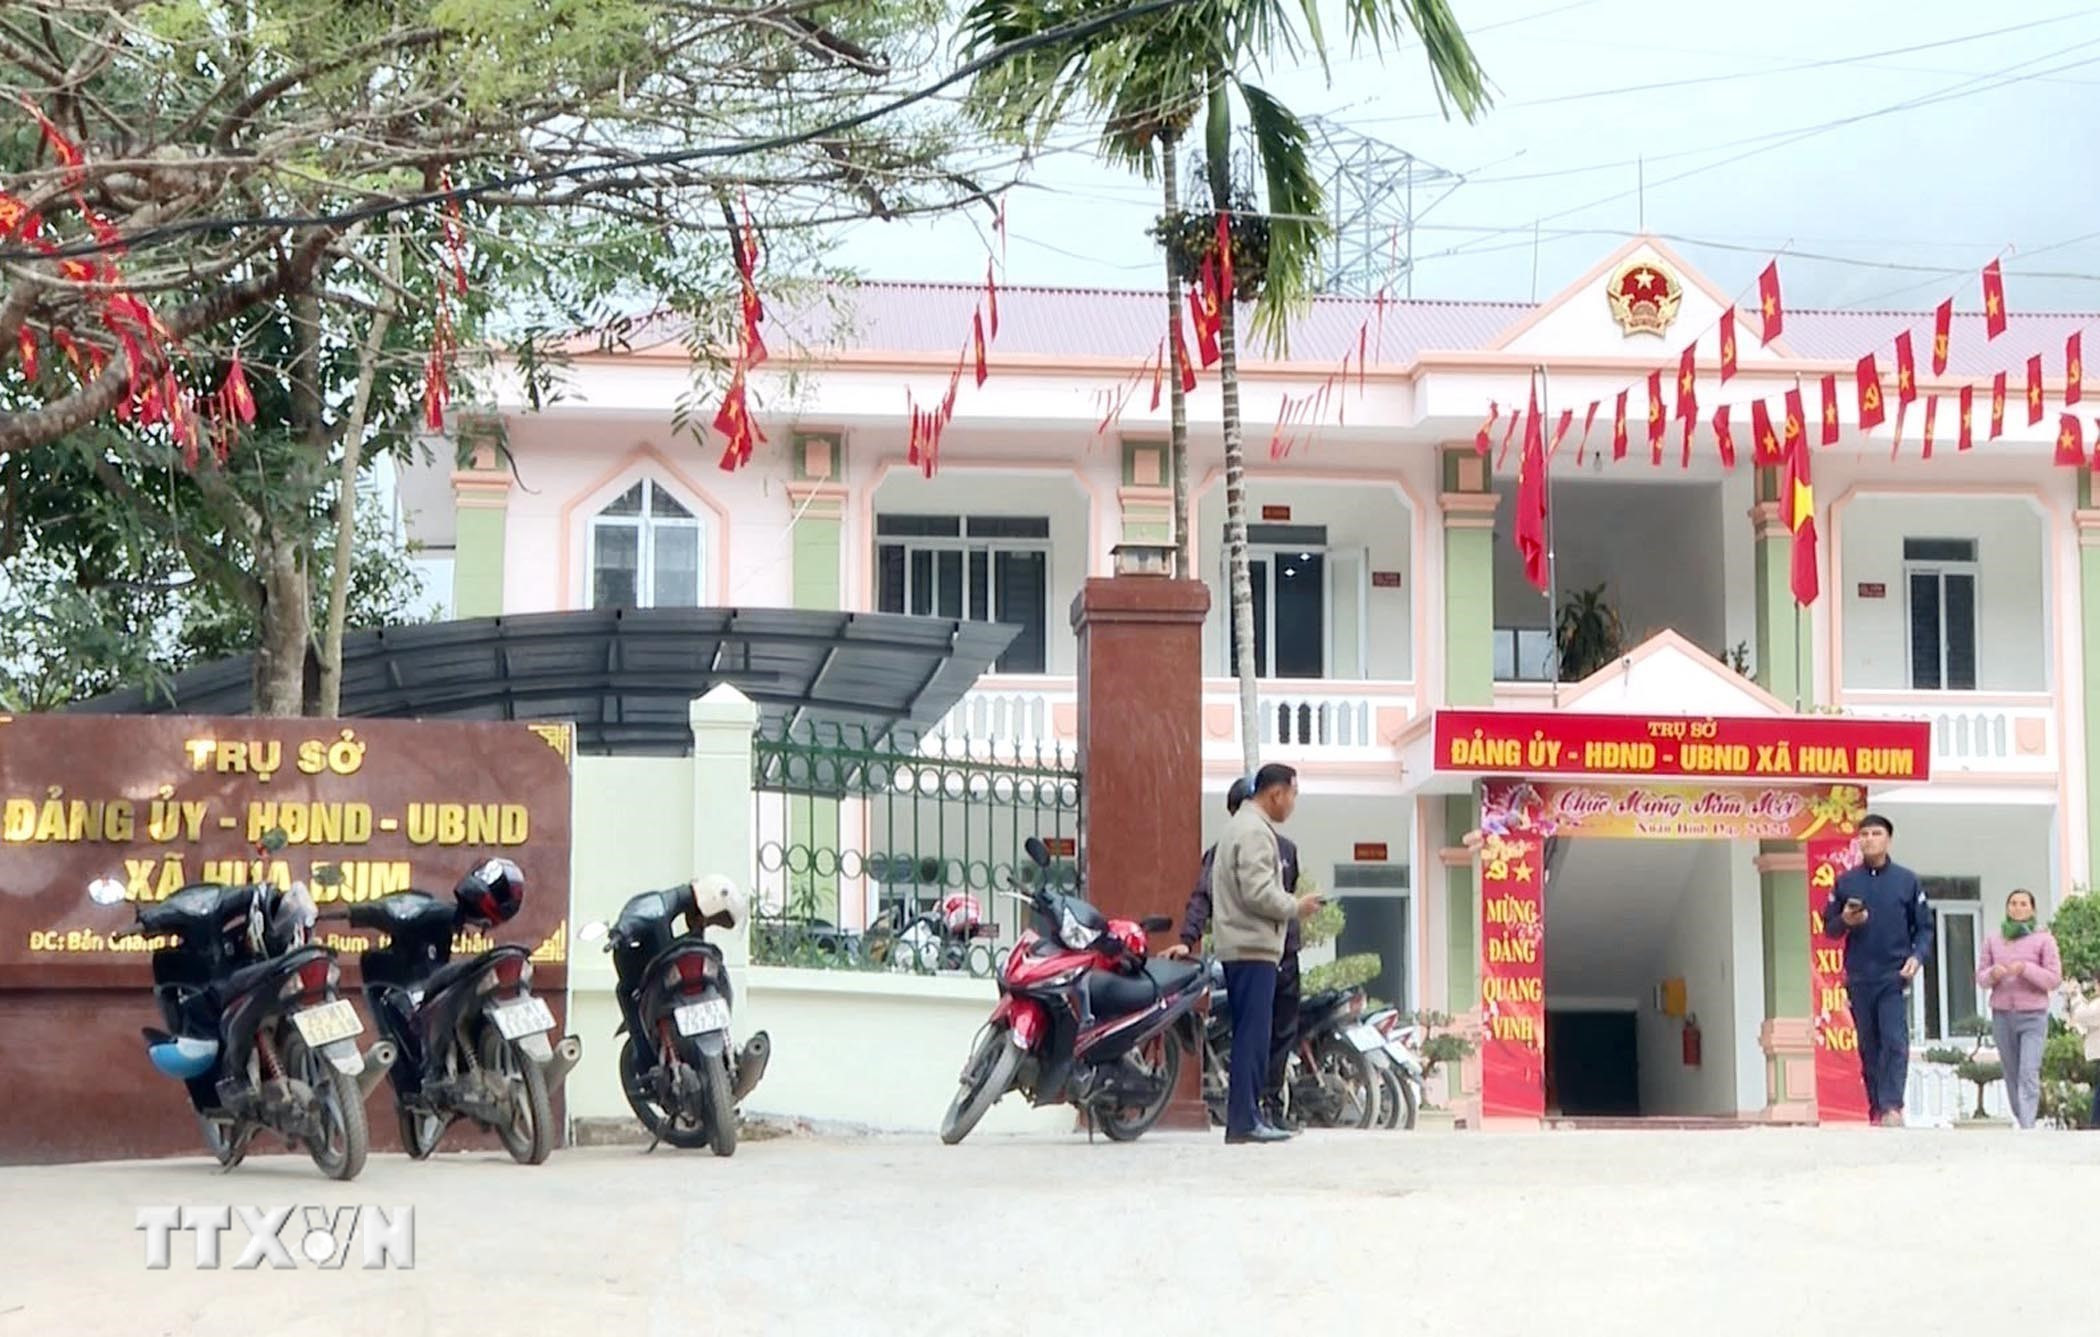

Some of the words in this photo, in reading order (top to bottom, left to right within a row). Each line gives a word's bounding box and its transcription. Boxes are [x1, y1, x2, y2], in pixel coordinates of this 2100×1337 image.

[1649, 721, 1686, 741] TRỤ
[1691, 717, 1717, 738] SỞ
[185, 739, 281, 782] TRỤ
[297, 729, 366, 774] SỞ
[1451, 728, 1521, 766] ĐẢNG
[1528, 730, 1561, 767] ỦY
[1585, 741, 1655, 769] HĐND
[1680, 744, 1749, 772] UBND
[1756, 740, 1792, 773] XÃ
[1800, 746, 1849, 774] HUA
[1856, 748, 1913, 775] BUM
[4, 784, 135, 842] ĐẢNG
[149, 784, 208, 842] ỦY
[248, 802, 372, 844] HĐND
[408, 803, 528, 844] UBND
[124, 852, 186, 901] XÃ
[30, 930, 64, 951] ĐC:
[67, 927, 103, 952] Bản
[1489, 931, 1535, 963] ĐẢNG
[1483, 977, 1542, 1003] QUANG
[1491, 1015, 1534, 1041] VINH
